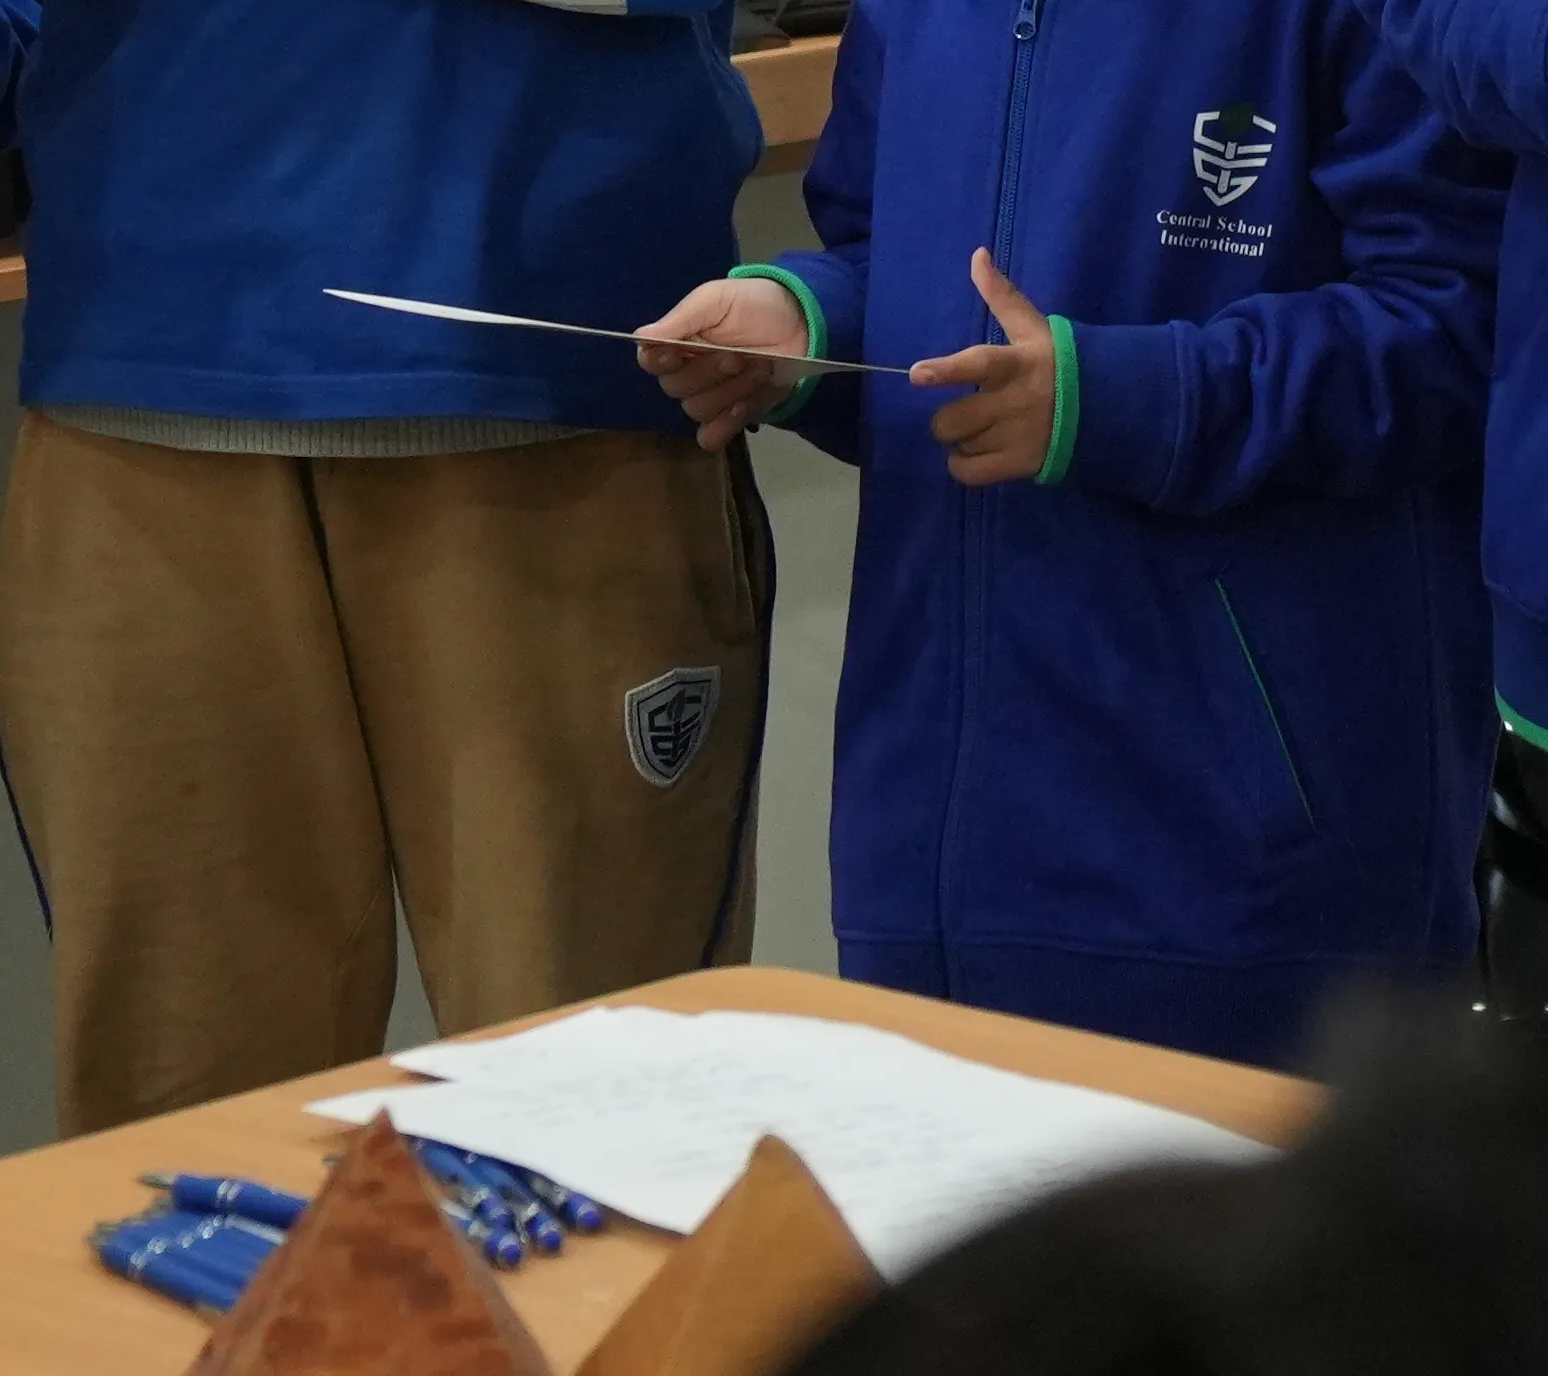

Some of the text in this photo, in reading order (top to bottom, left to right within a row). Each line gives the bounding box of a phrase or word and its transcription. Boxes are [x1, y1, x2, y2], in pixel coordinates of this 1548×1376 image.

[1156, 209, 1273, 238] Central School
[1160, 229, 1265, 257] International
